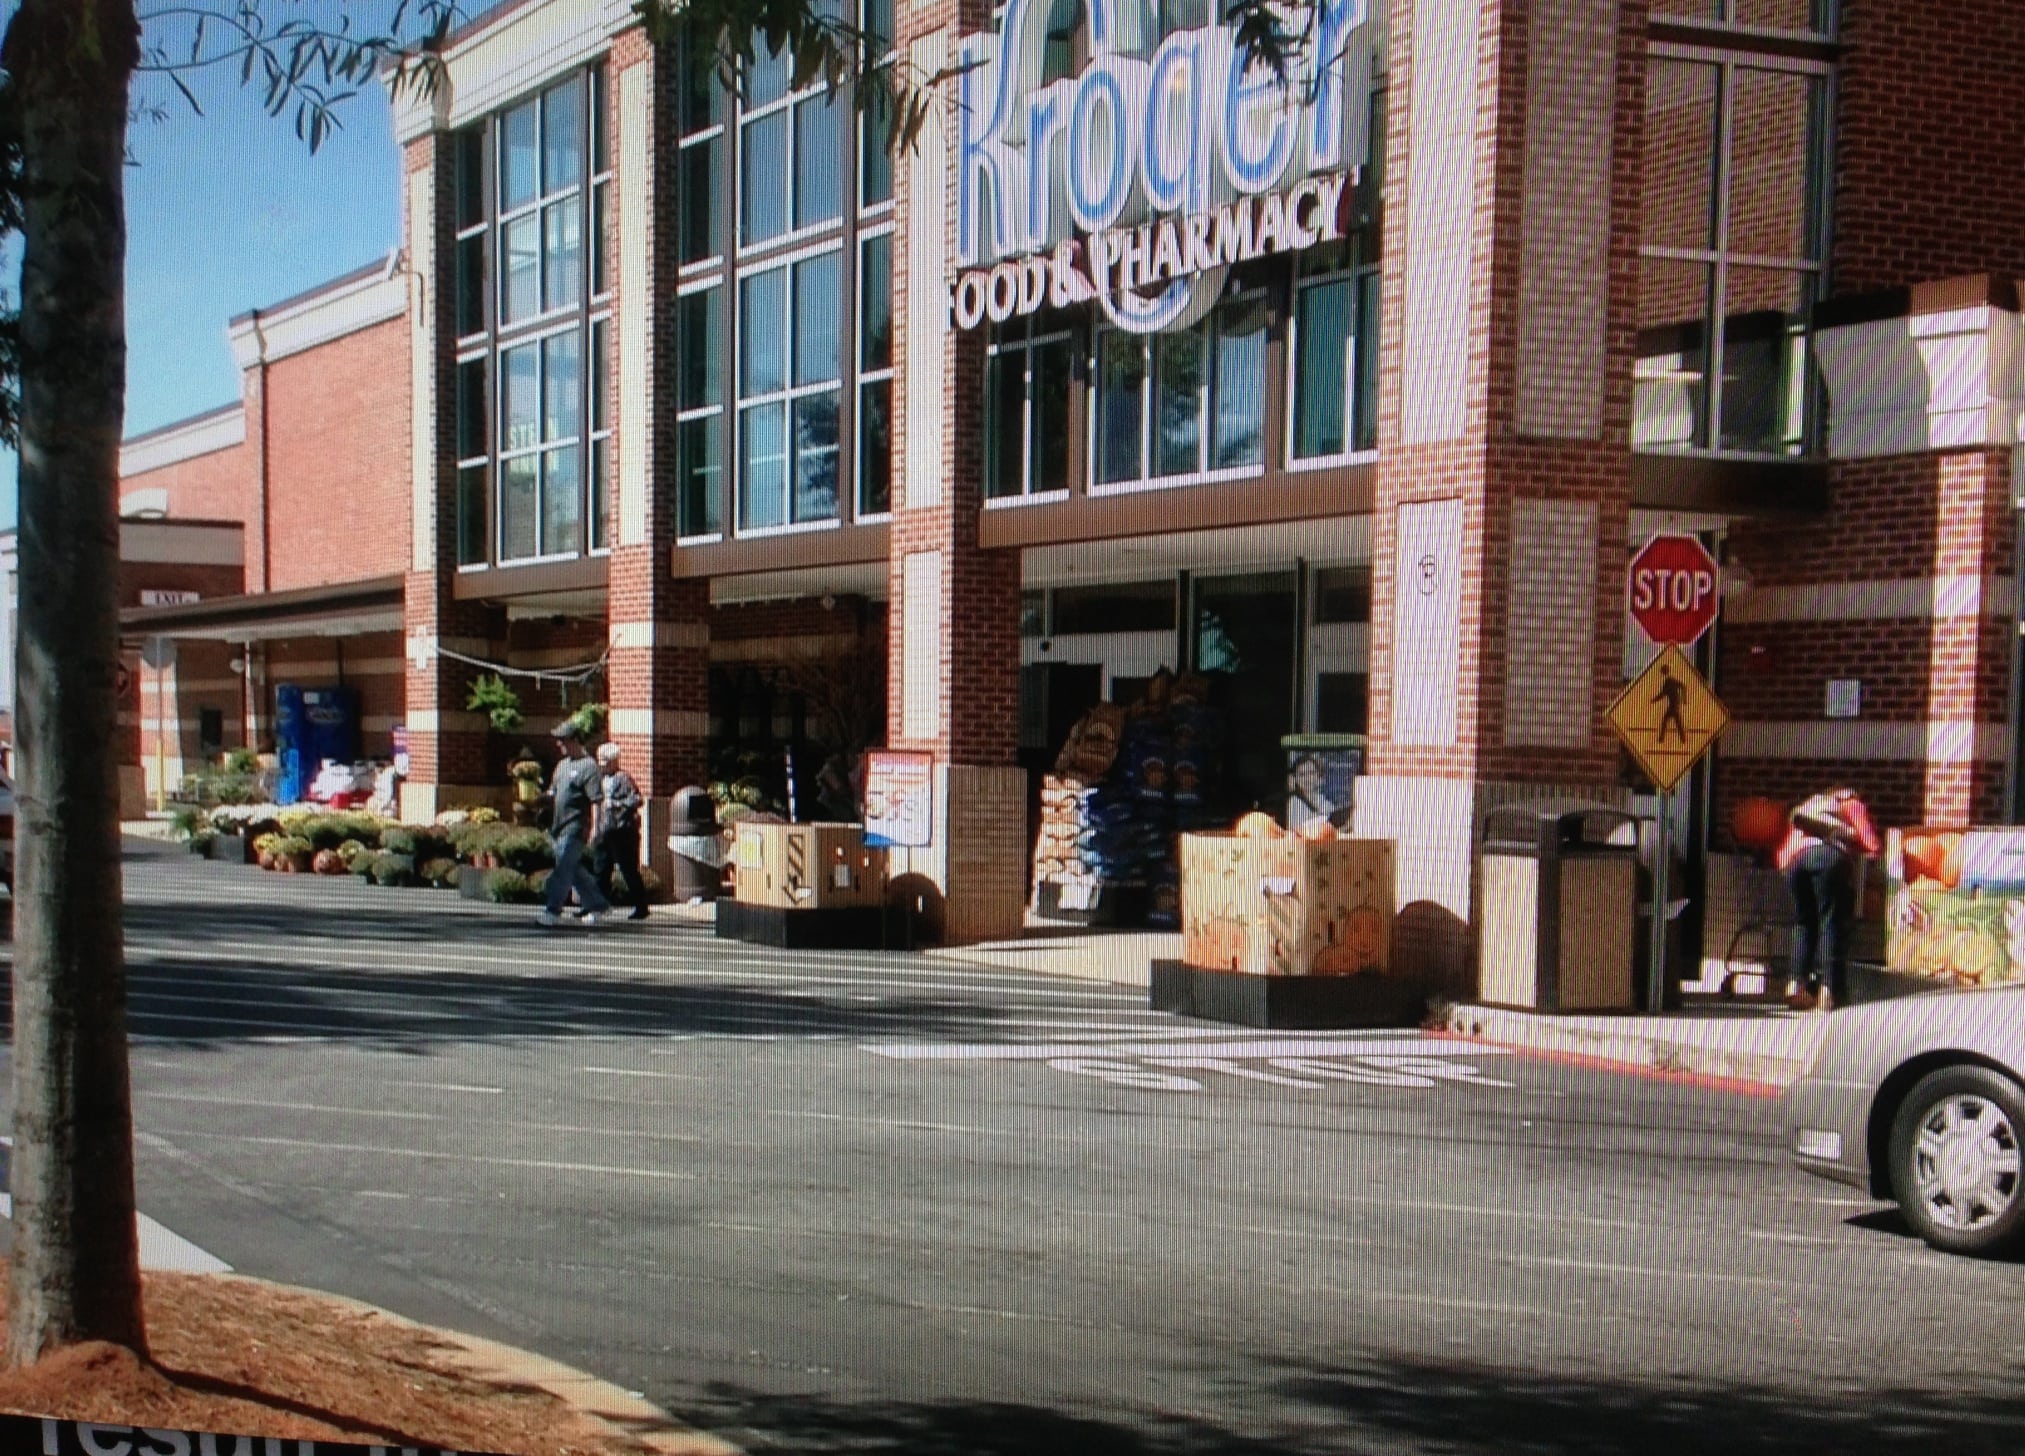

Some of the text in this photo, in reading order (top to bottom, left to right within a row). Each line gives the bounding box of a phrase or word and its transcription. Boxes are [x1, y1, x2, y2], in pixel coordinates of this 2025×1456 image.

[949, 254, 1048, 330] OOD
[1092, 163, 1361, 292] PHARMACY
[1634, 568, 1712, 612] STOP
